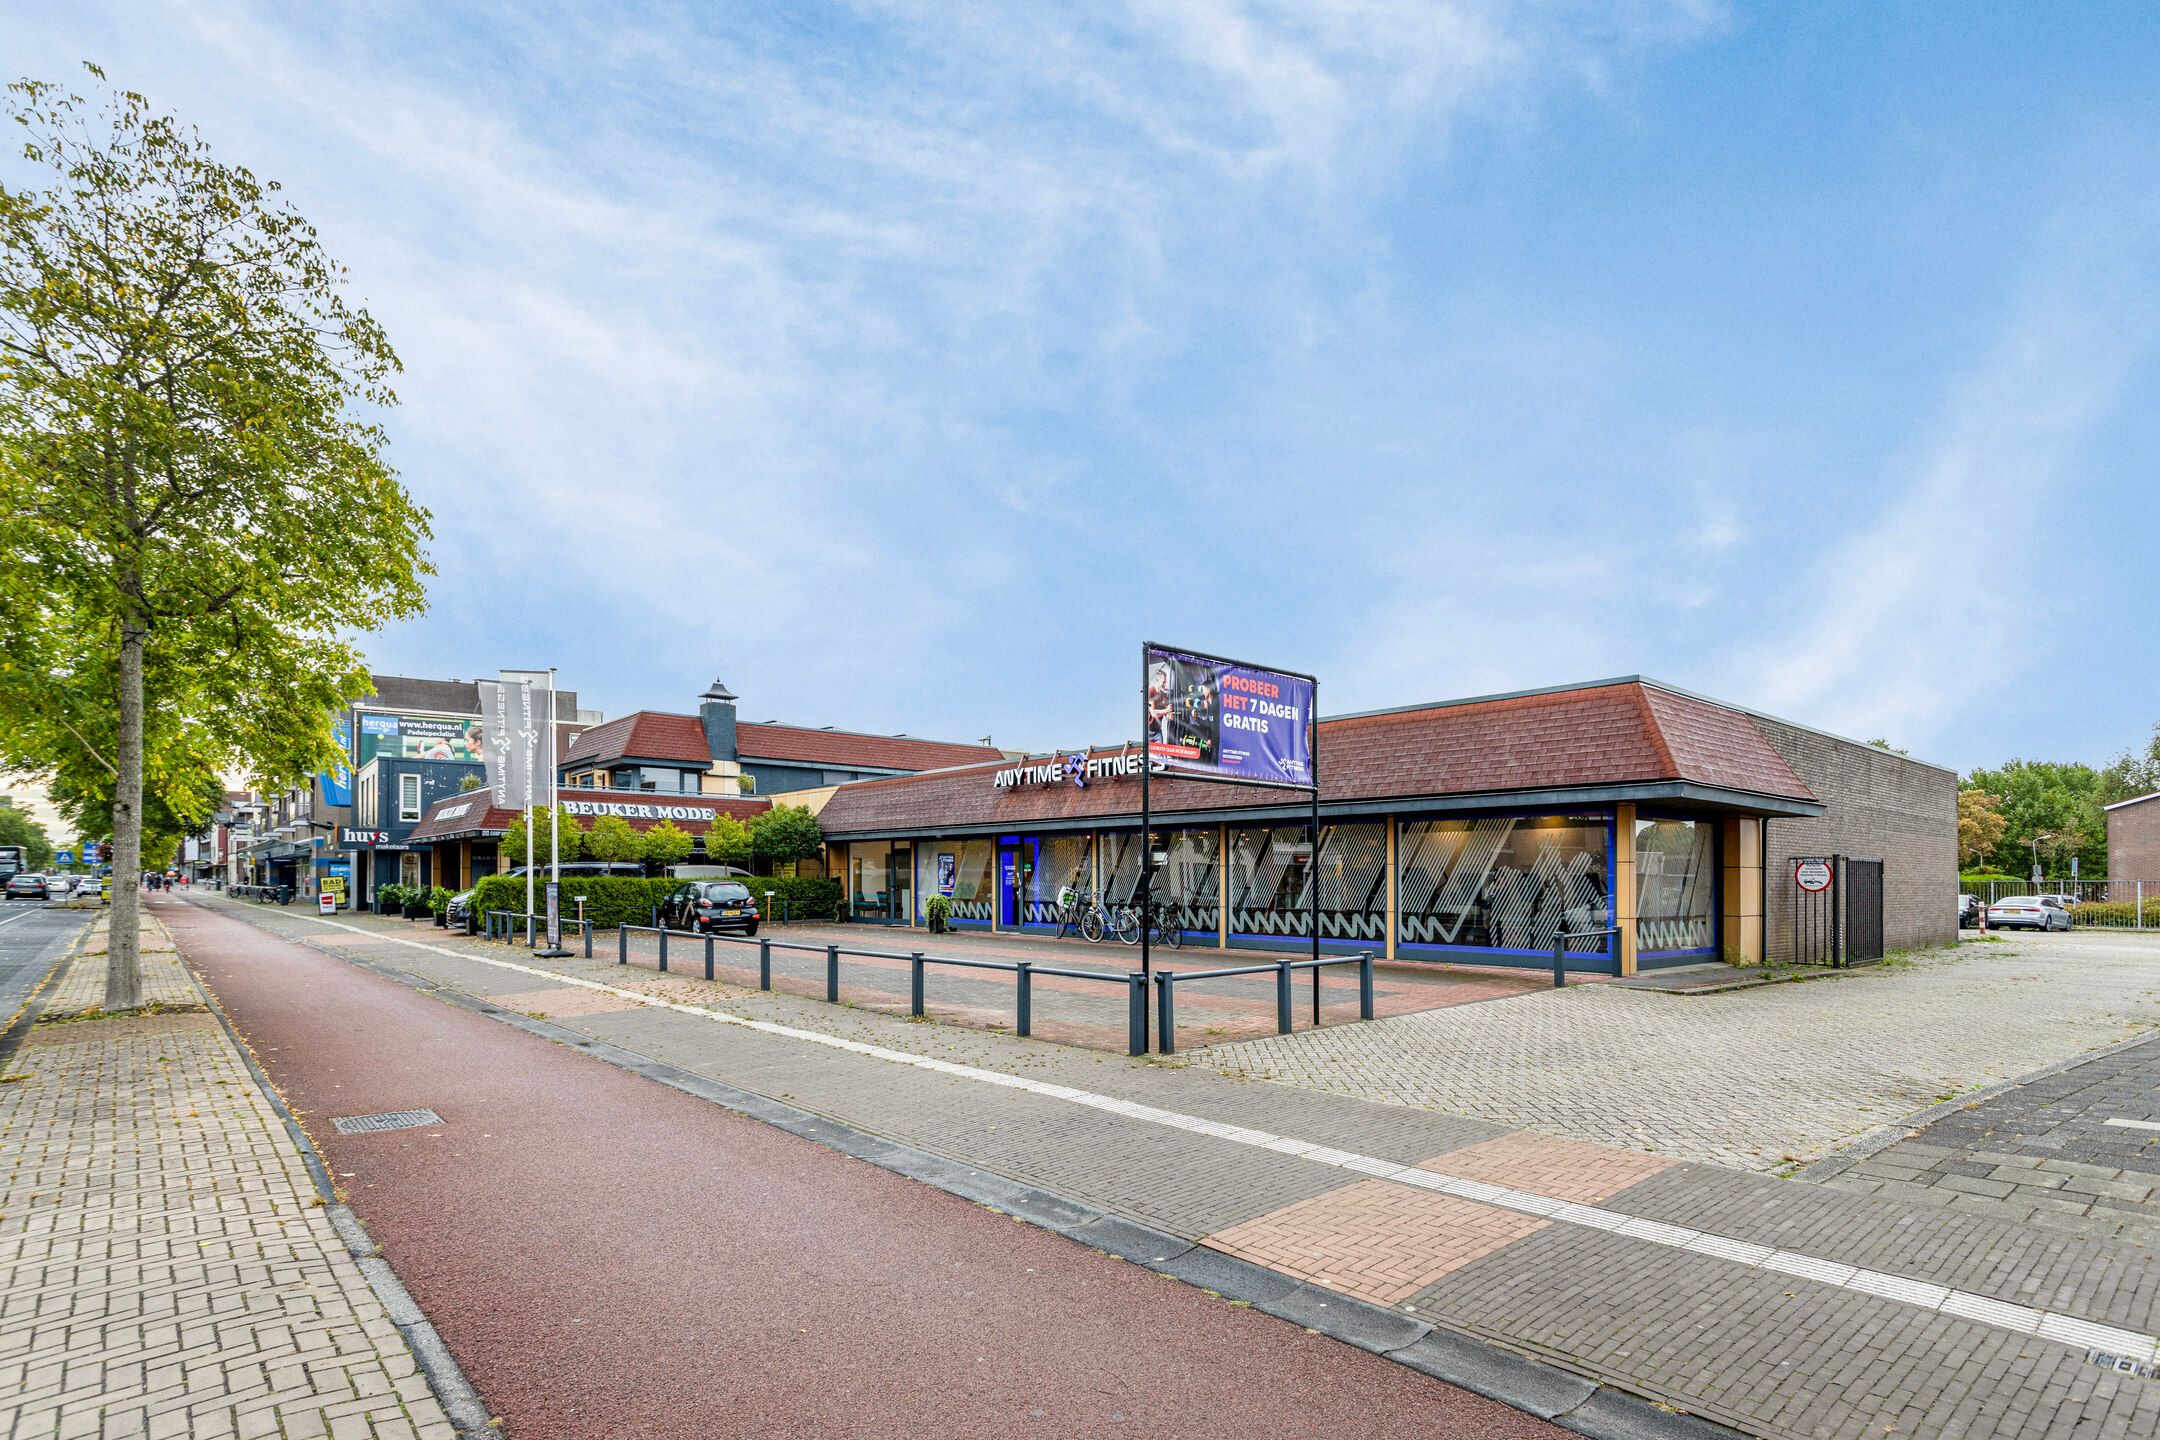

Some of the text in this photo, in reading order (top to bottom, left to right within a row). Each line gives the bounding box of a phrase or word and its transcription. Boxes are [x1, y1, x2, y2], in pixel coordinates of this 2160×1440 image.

[1222, 674, 1279, 699] PROBEER
[1223, 693, 1299, 721] HET 7 DAGEN
[362, 717, 398, 729] herqua
[399, 721, 463, 732] www.herqua.nl
[1223, 713, 1269, 734] GRATIS
[407, 729, 456, 738] Padelspecialist
[993, 763, 1063, 788] ANYTIME
[562, 801, 714, 820] BEUKER MODE
[343, 828, 389, 845] huys
